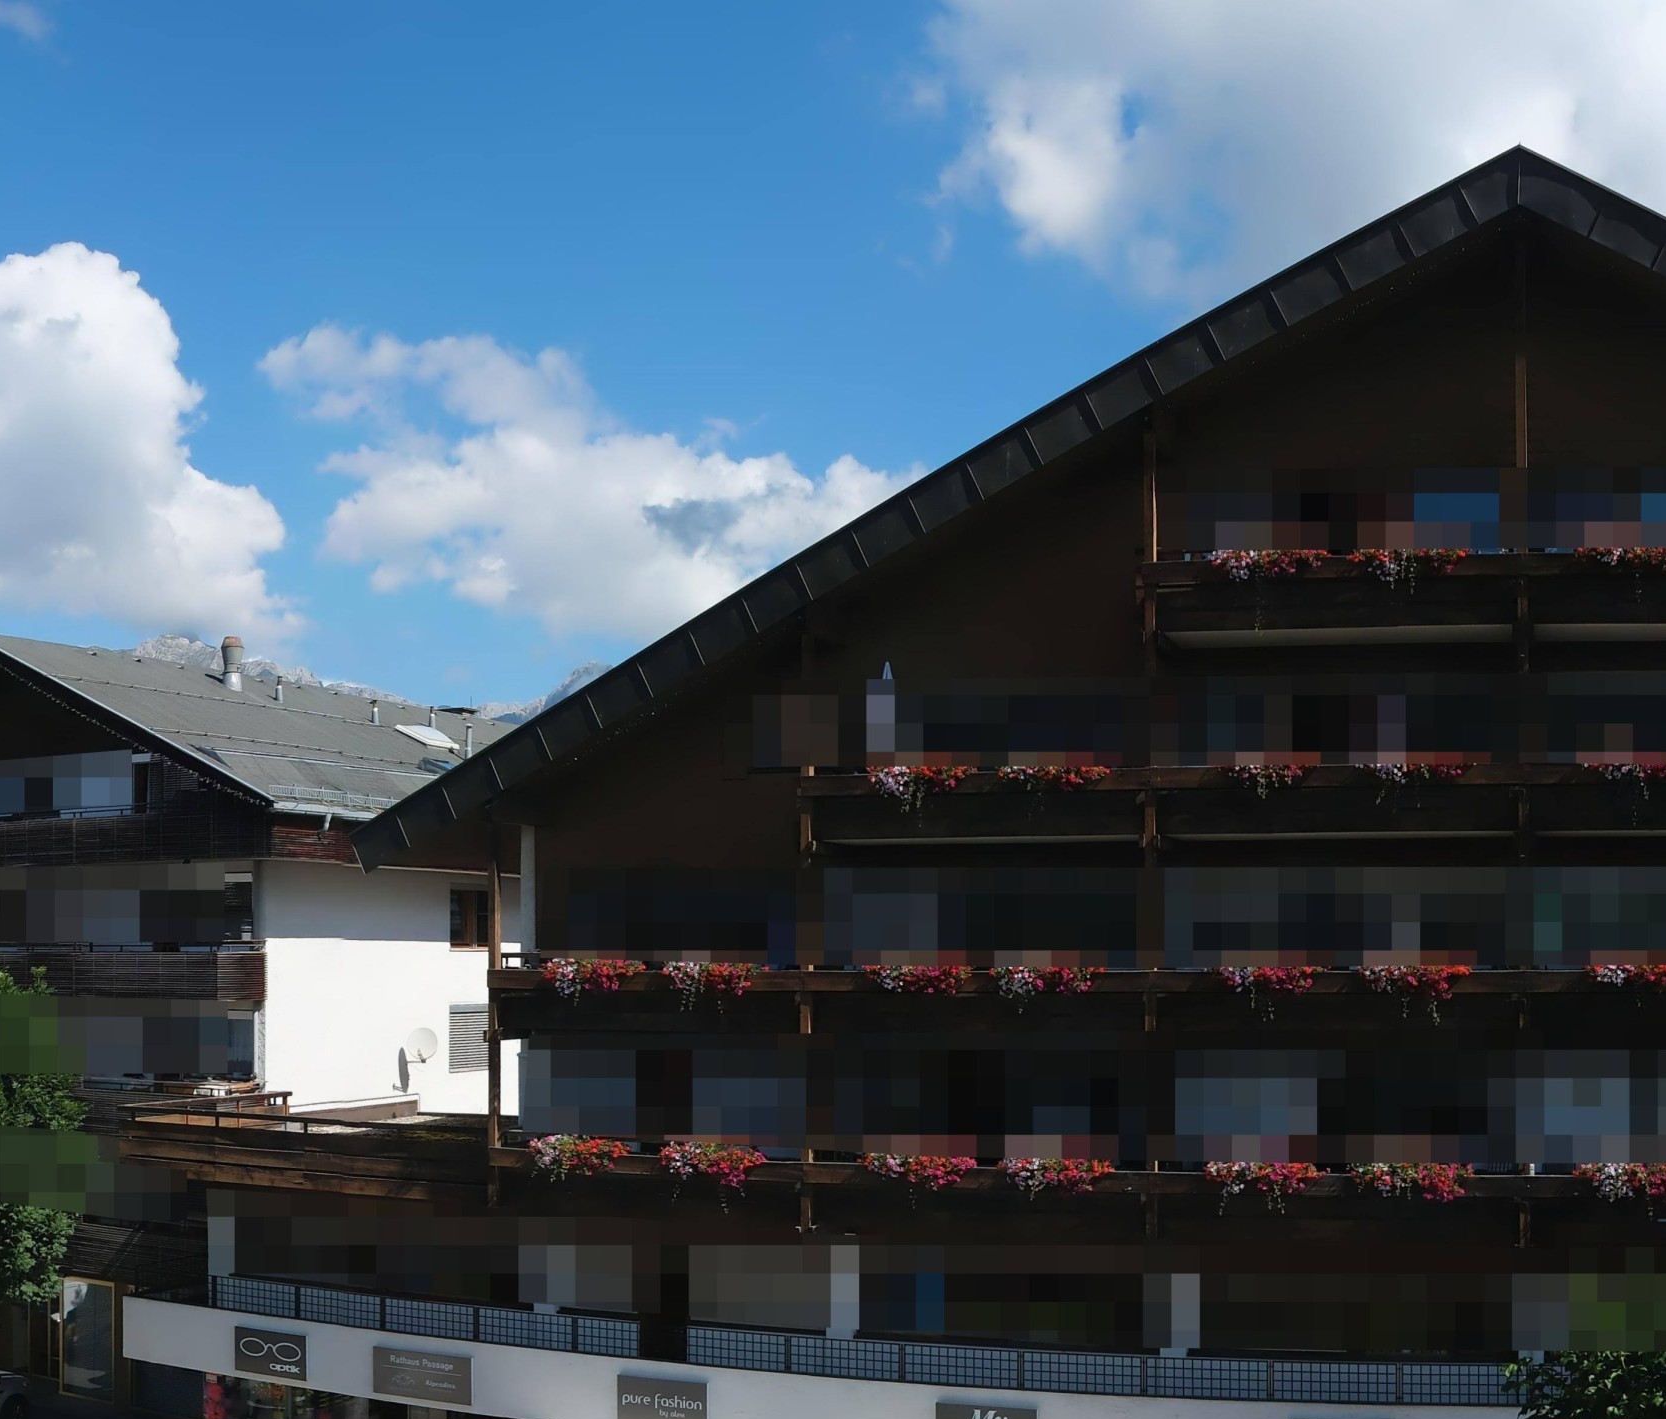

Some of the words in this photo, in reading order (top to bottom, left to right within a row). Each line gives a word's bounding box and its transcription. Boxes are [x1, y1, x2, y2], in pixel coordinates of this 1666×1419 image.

[269, 1363, 301, 1374] optik
[390, 1354, 421, 1367] Rathaus
[422, 1358, 454, 1371] Passage
[622, 1393, 651, 1407] pure
[654, 1393, 703, 1410] fashion
[659, 1408, 669, 1418] by
